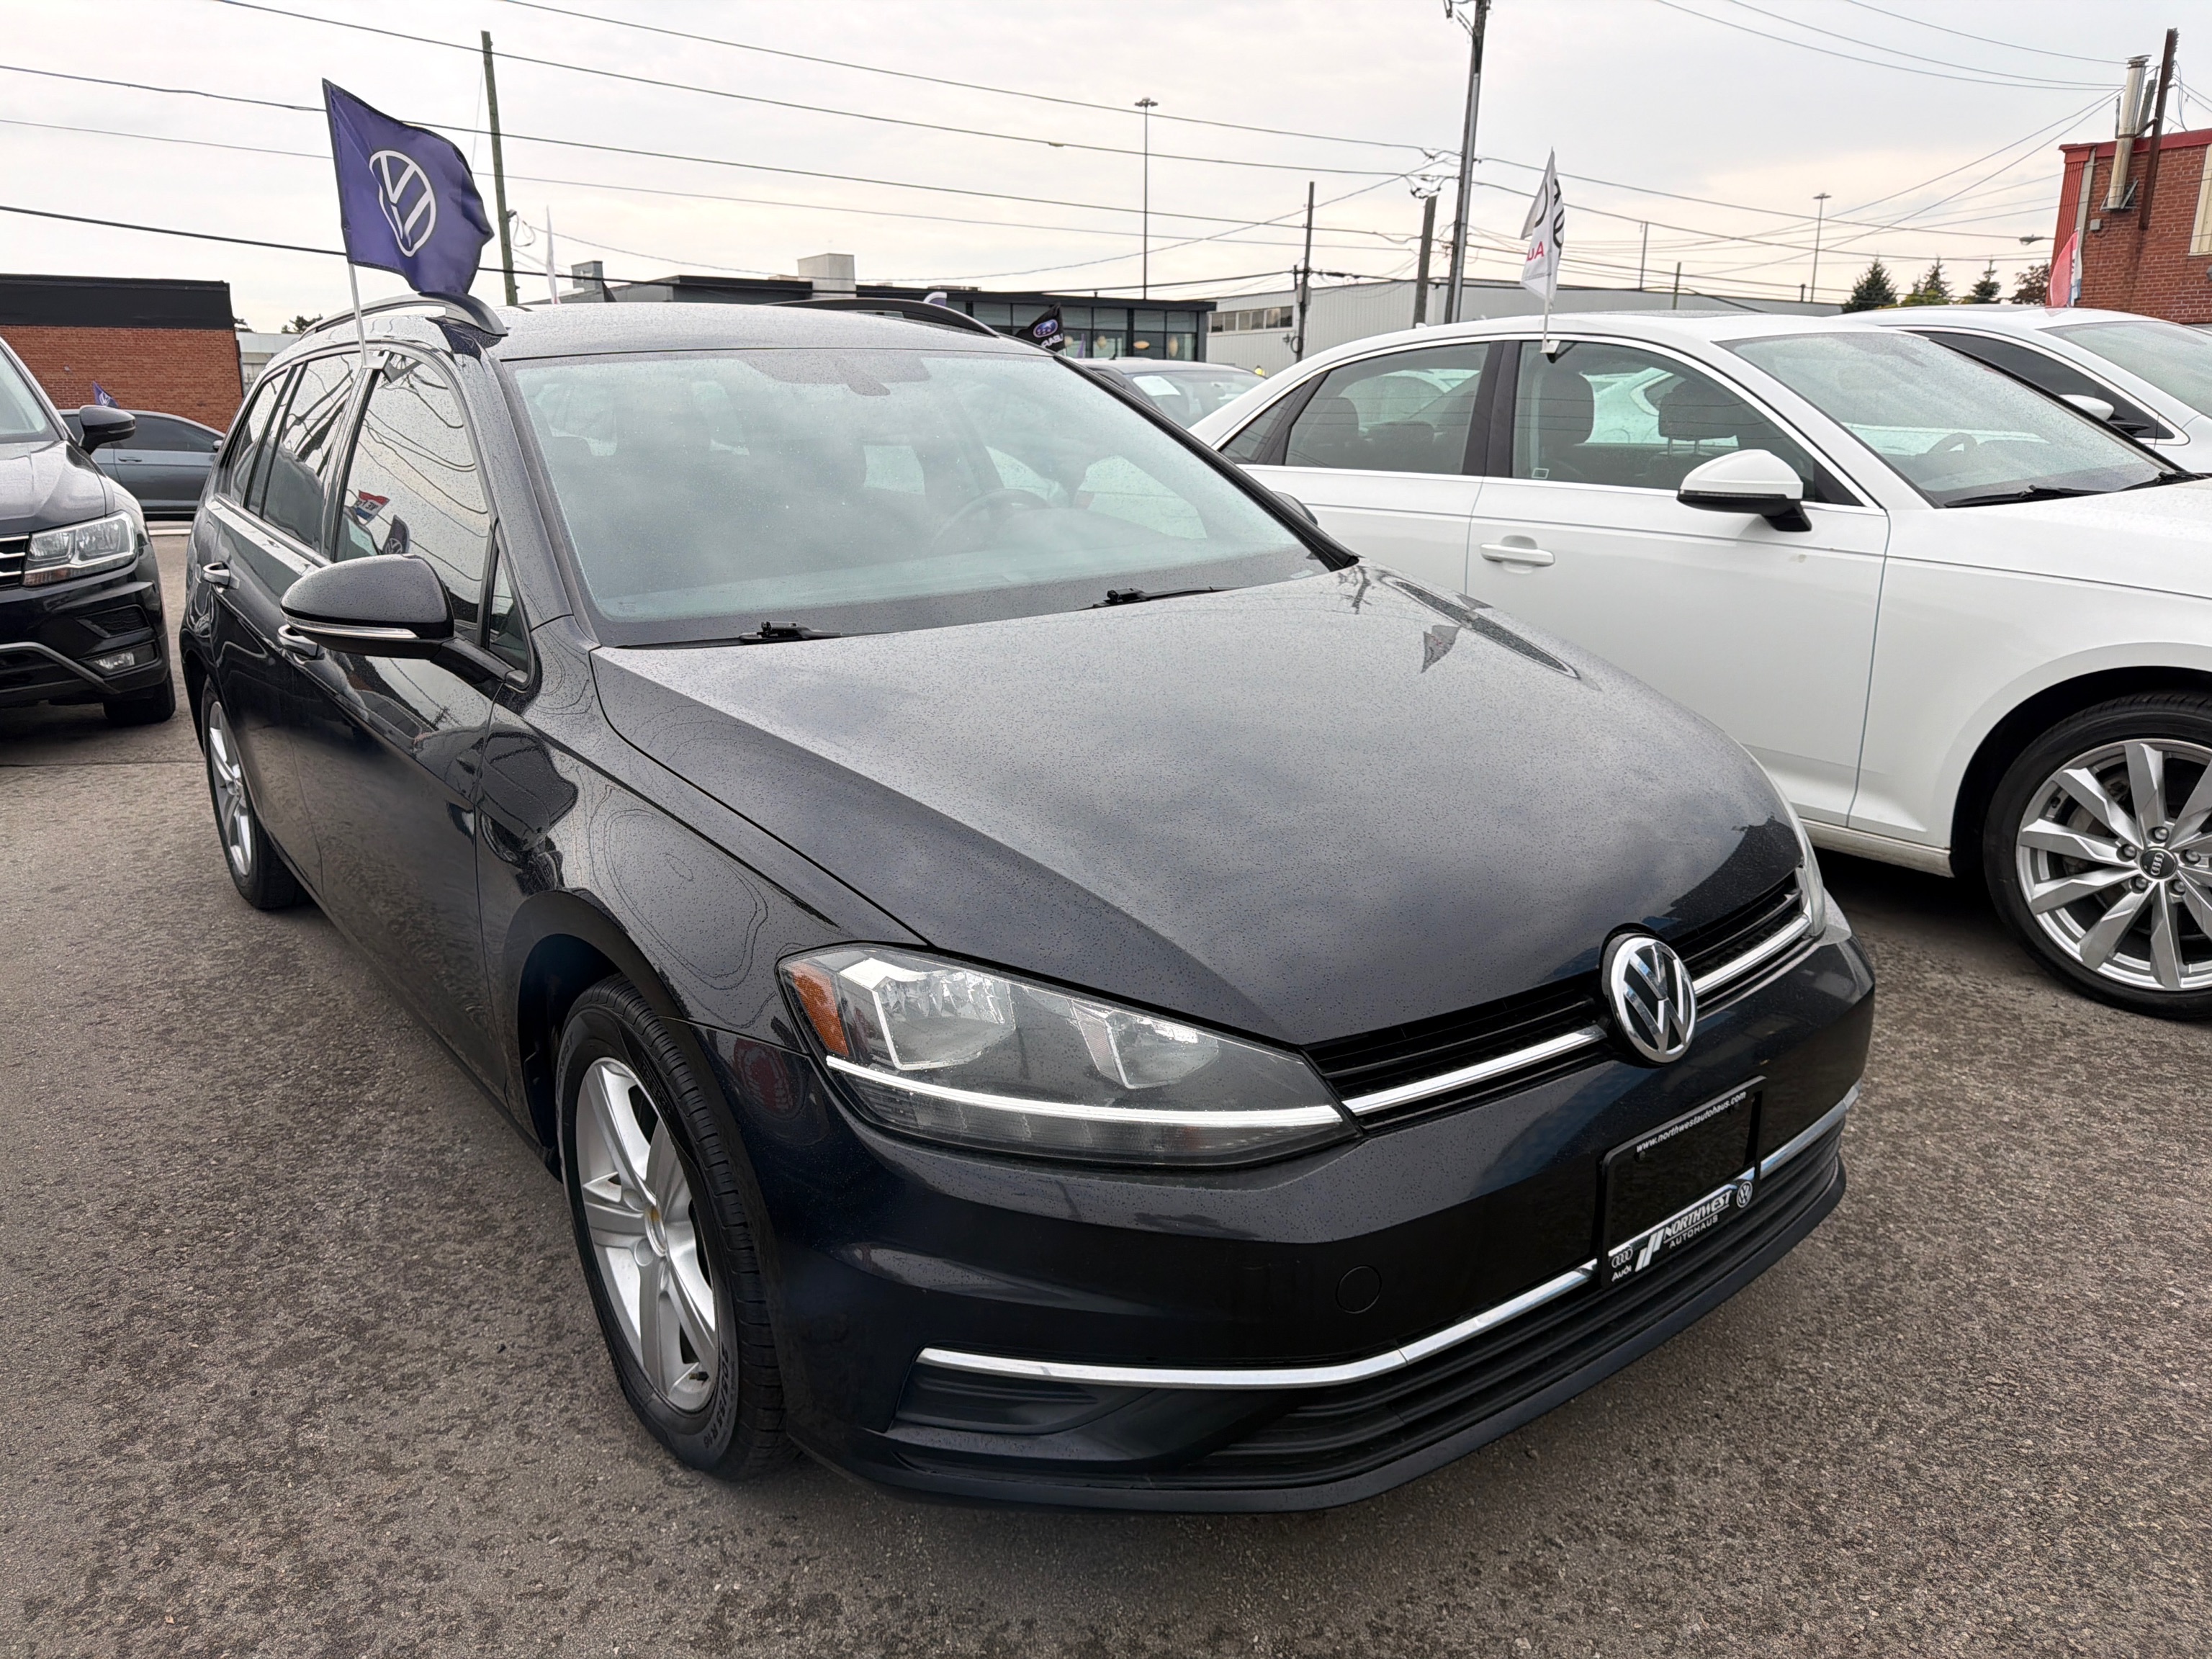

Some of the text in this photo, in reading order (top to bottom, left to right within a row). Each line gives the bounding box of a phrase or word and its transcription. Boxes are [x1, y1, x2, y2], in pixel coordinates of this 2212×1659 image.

[1636, 1091, 1747, 1152] www.northwestautohaus.com
[1663, 1190, 1732, 1239] NORTHWEST
[1669, 1215, 1718, 1249] AUTOHAUS
[1611, 1265, 1632, 1282] Audi
